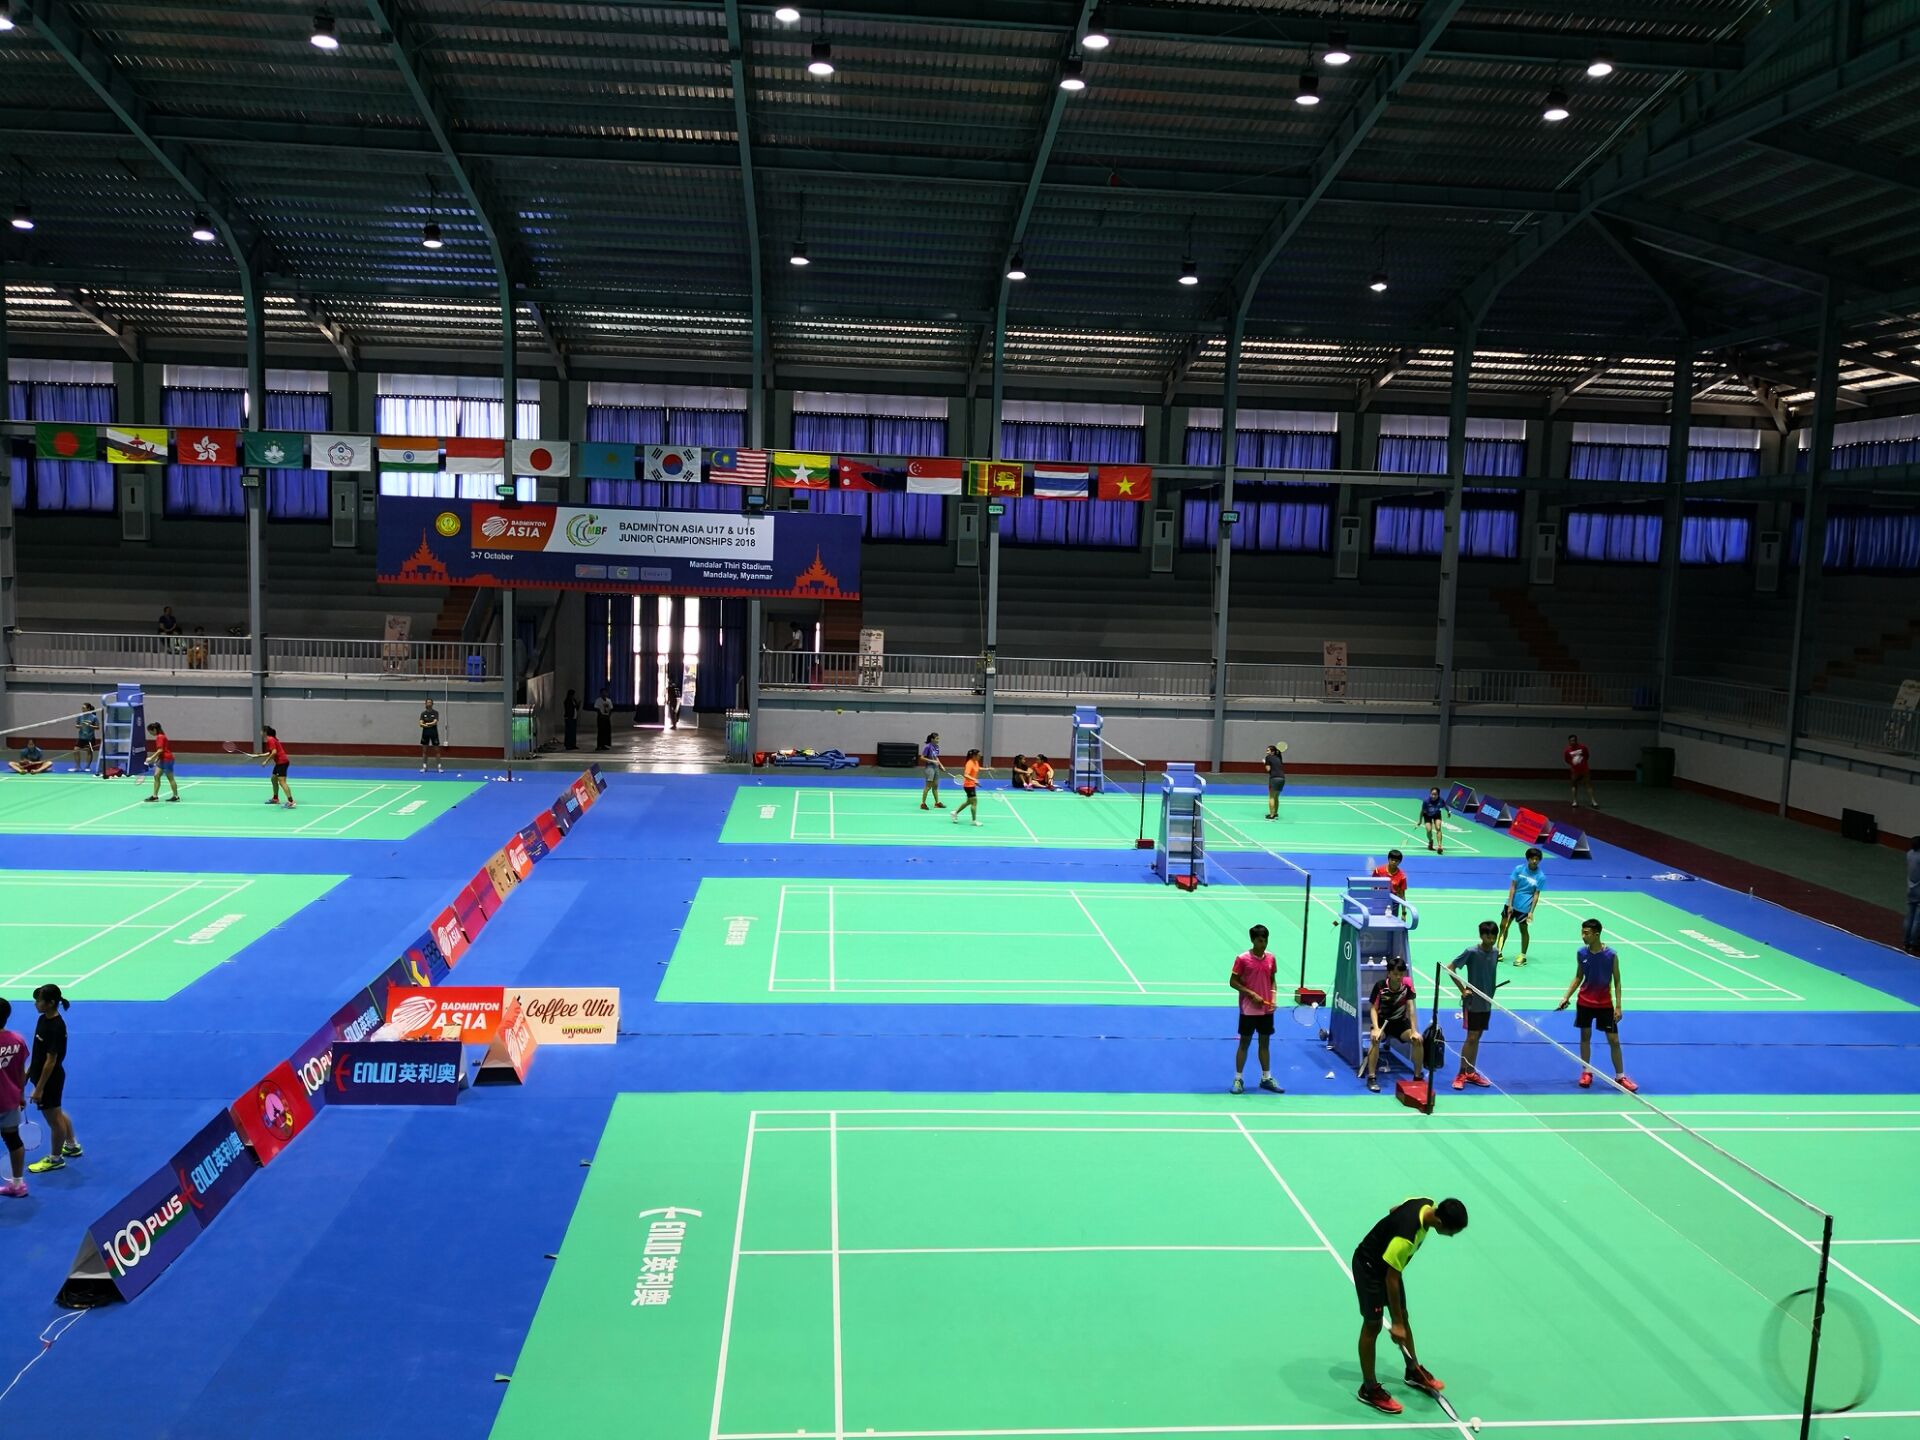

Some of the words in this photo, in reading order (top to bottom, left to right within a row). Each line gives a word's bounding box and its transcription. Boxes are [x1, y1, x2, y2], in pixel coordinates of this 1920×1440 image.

[506, 527, 540, 538] ASIA
[587, 526, 607, 535] MBF
[619, 522, 680, 533] BADMINTON
[681, 524, 704, 533] ASIA
[706, 525, 725, 534] U17
[728, 527, 734, 535] &
[737, 527, 755, 536] U15
[618, 534, 654, 543] JUNIOR
[656, 535, 733, 546] CHAMPIONSHIPS
[735, 538, 756, 547] 2018
[470, 551, 483, 559] 3-7
[484, 552, 514, 560] October
[689, 560, 723, 569] Mandalar
[724, 562, 740, 570] Thiri
[741, 562, 773, 571] Stadium,
[703, 570, 739, 580] Mandalay,
[740, 572, 773, 581] Myanmar
[440, 1001, 500, 1012] BADMINTON
[526, 999, 578, 1024] Coffee
[582, 998, 615, 1018] Win
[431, 1012, 487, 1030] ASIA
[0, 1044, 20, 1056] PAN
[353, 1062, 397, 1084] ENLIO
[398, 1063, 456, 1084] 英利奥
